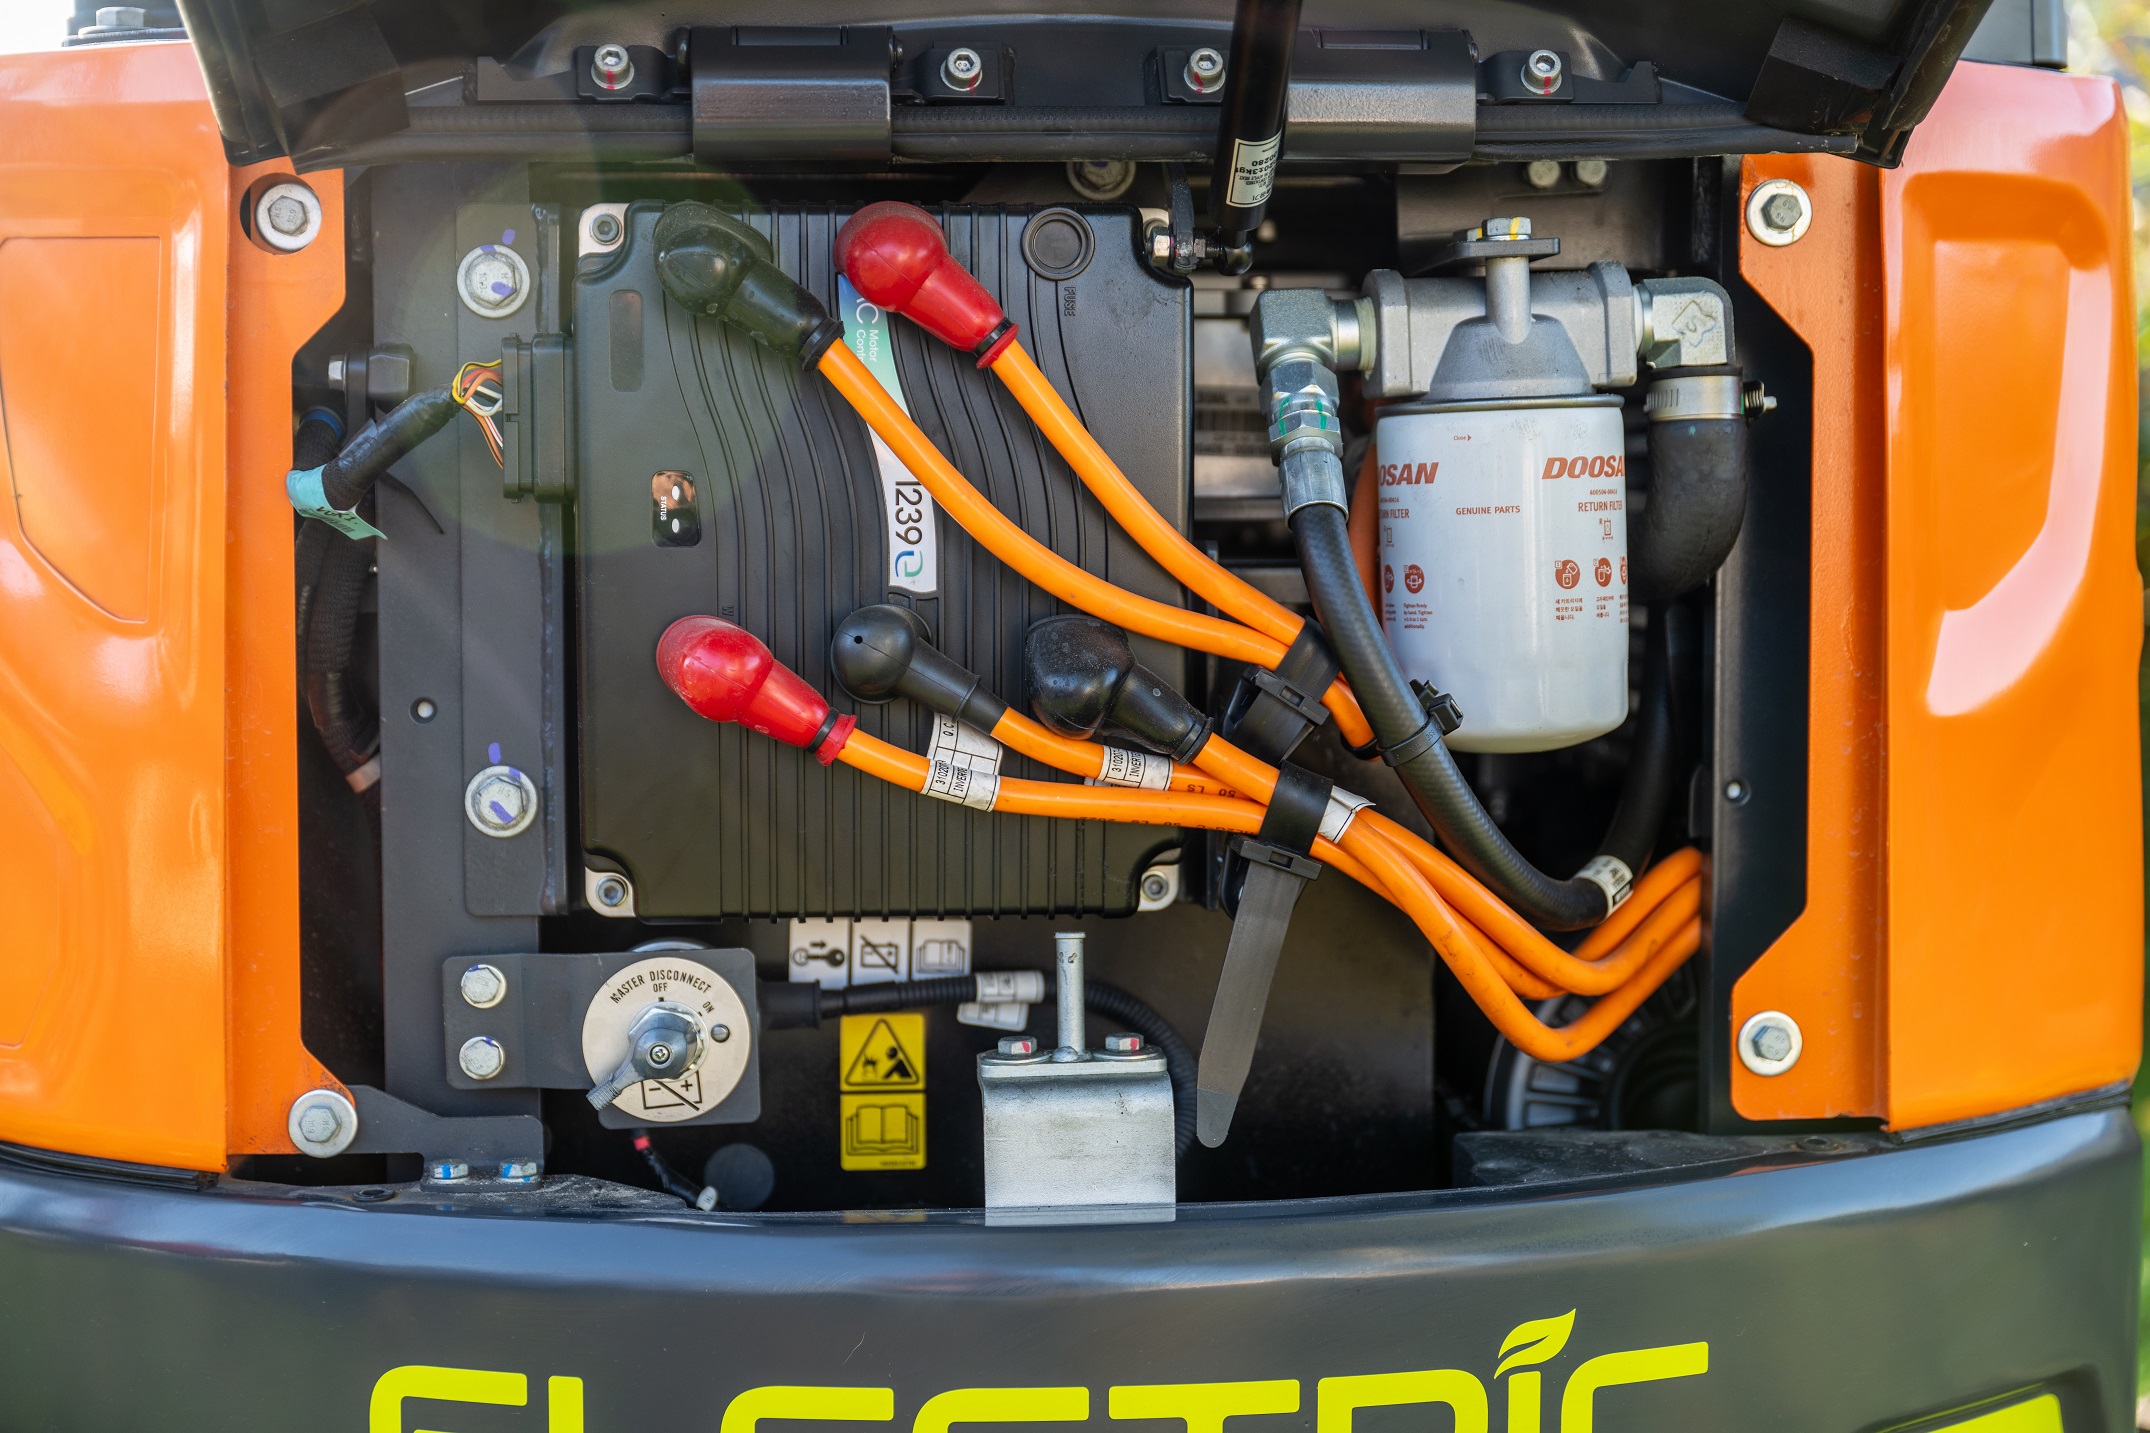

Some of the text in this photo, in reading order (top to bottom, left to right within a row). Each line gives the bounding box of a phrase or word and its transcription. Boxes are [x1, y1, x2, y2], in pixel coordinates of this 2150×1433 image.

[1063, 286, 1076, 317] FUSE
[868, 329, 879, 363] Motor
[894, 480, 923, 546] 1239
[1390, 508, 1410, 519] FILTER
[1455, 505, 1521, 516] GENUINE PARTS
[1578, 501, 1608, 512] RETURN
[1187, 783, 1237, 798] 50 LS
[609, 969, 712, 1004] MASTER DISCONNECT
[652, 983, 668, 993] OFF
[702, 1001, 715, 1014] ON
